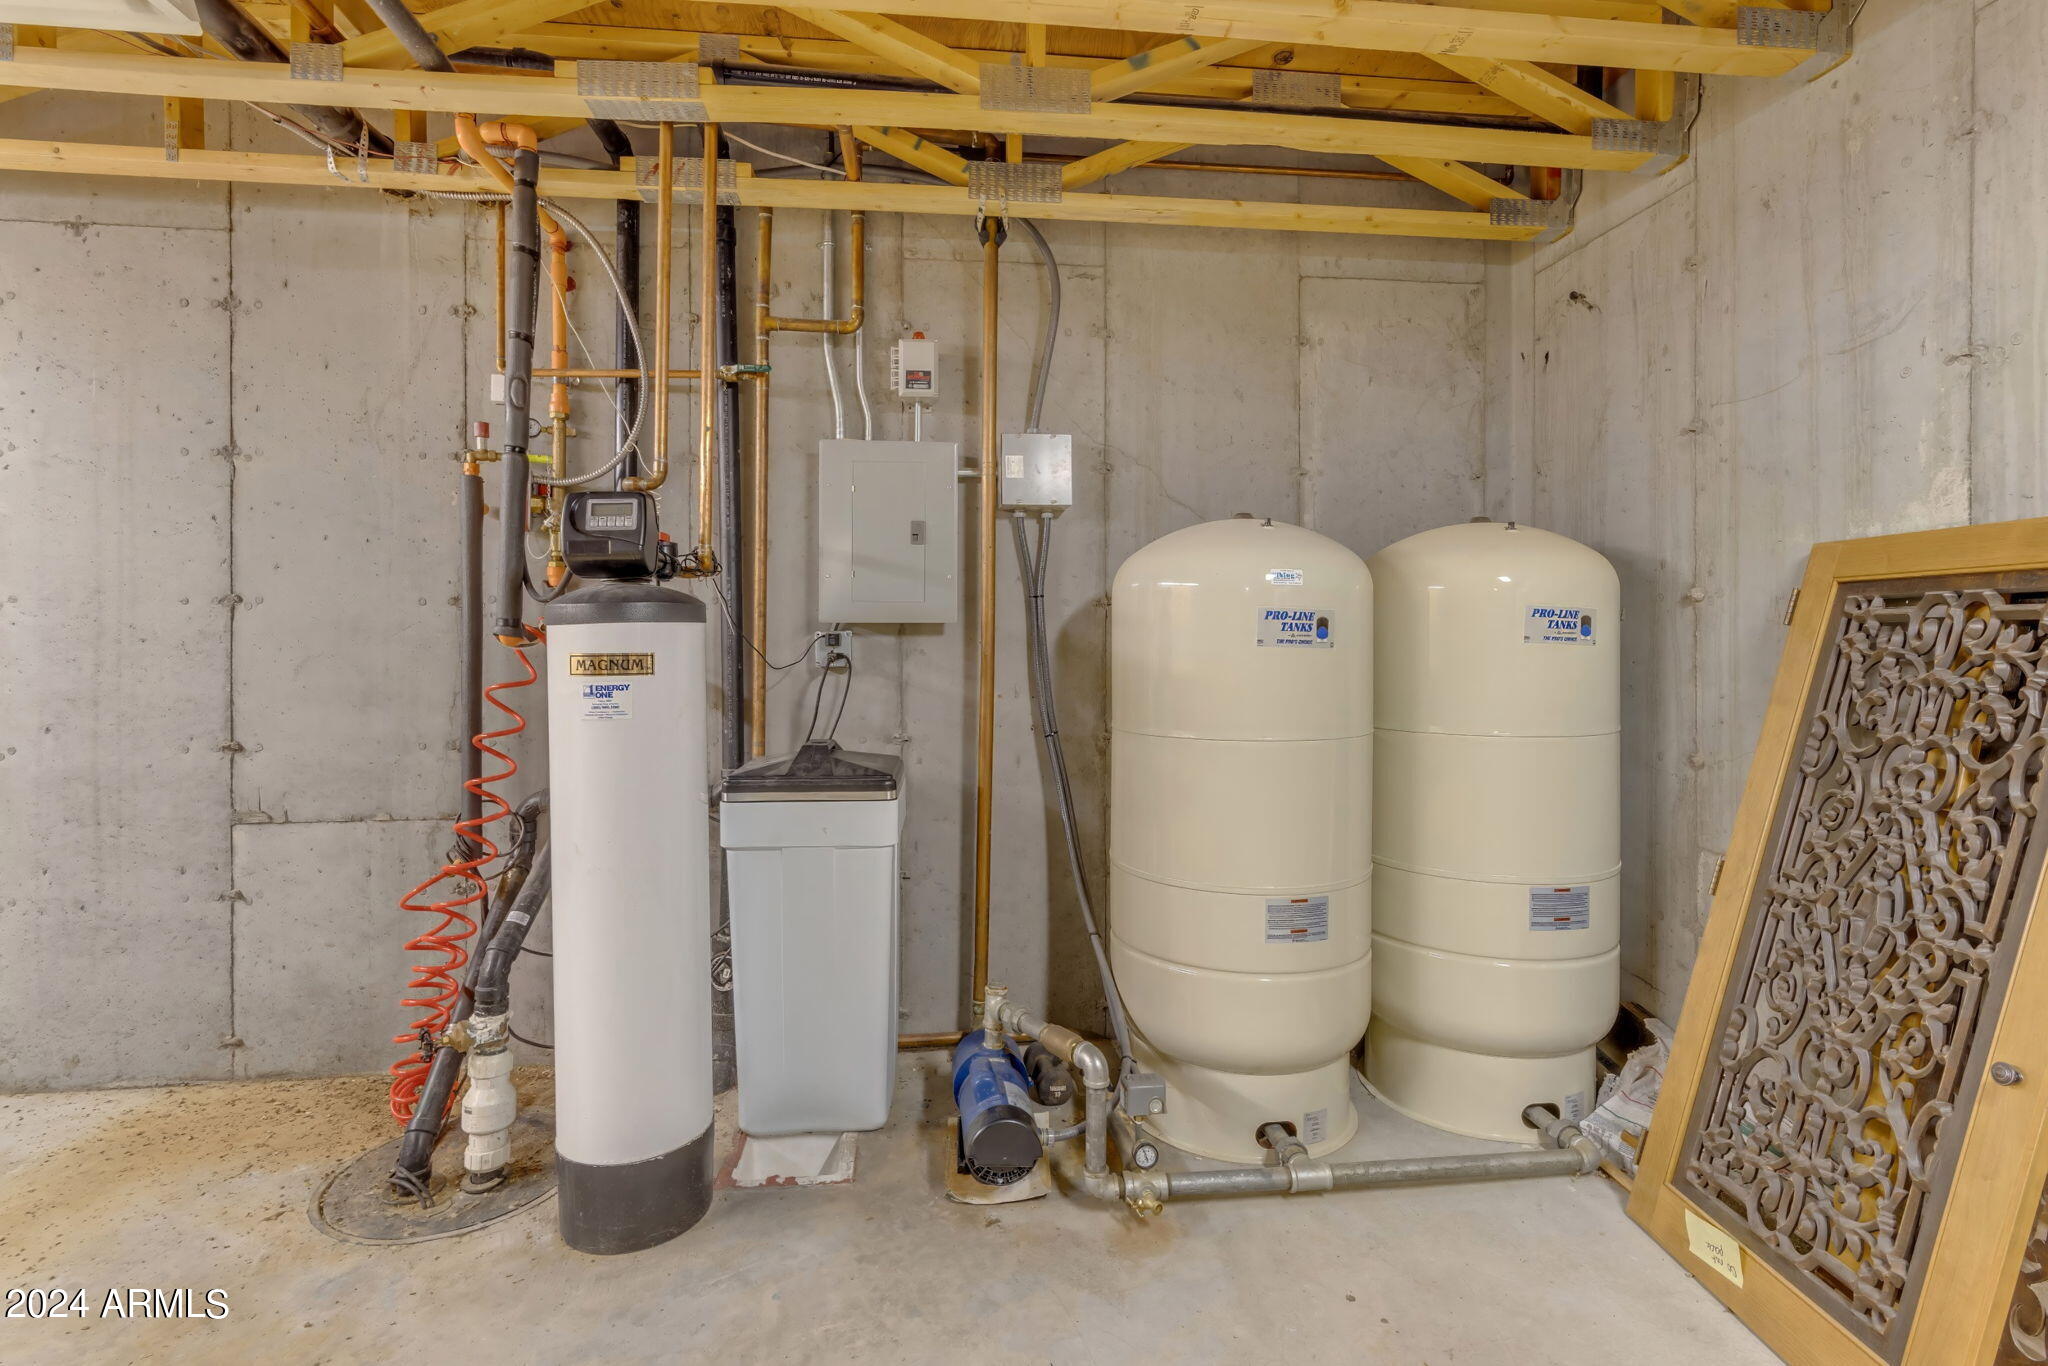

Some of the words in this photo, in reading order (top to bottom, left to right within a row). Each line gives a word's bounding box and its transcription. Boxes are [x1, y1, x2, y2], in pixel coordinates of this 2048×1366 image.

[1264, 610, 1316, 621] PRO-LINE
[1531, 608, 1580, 620] PRO-LINE
[1280, 622, 1314, 633] TANKS
[1547, 620, 1578, 630] TANKS
[575, 659, 643, 671] MAGNUM
